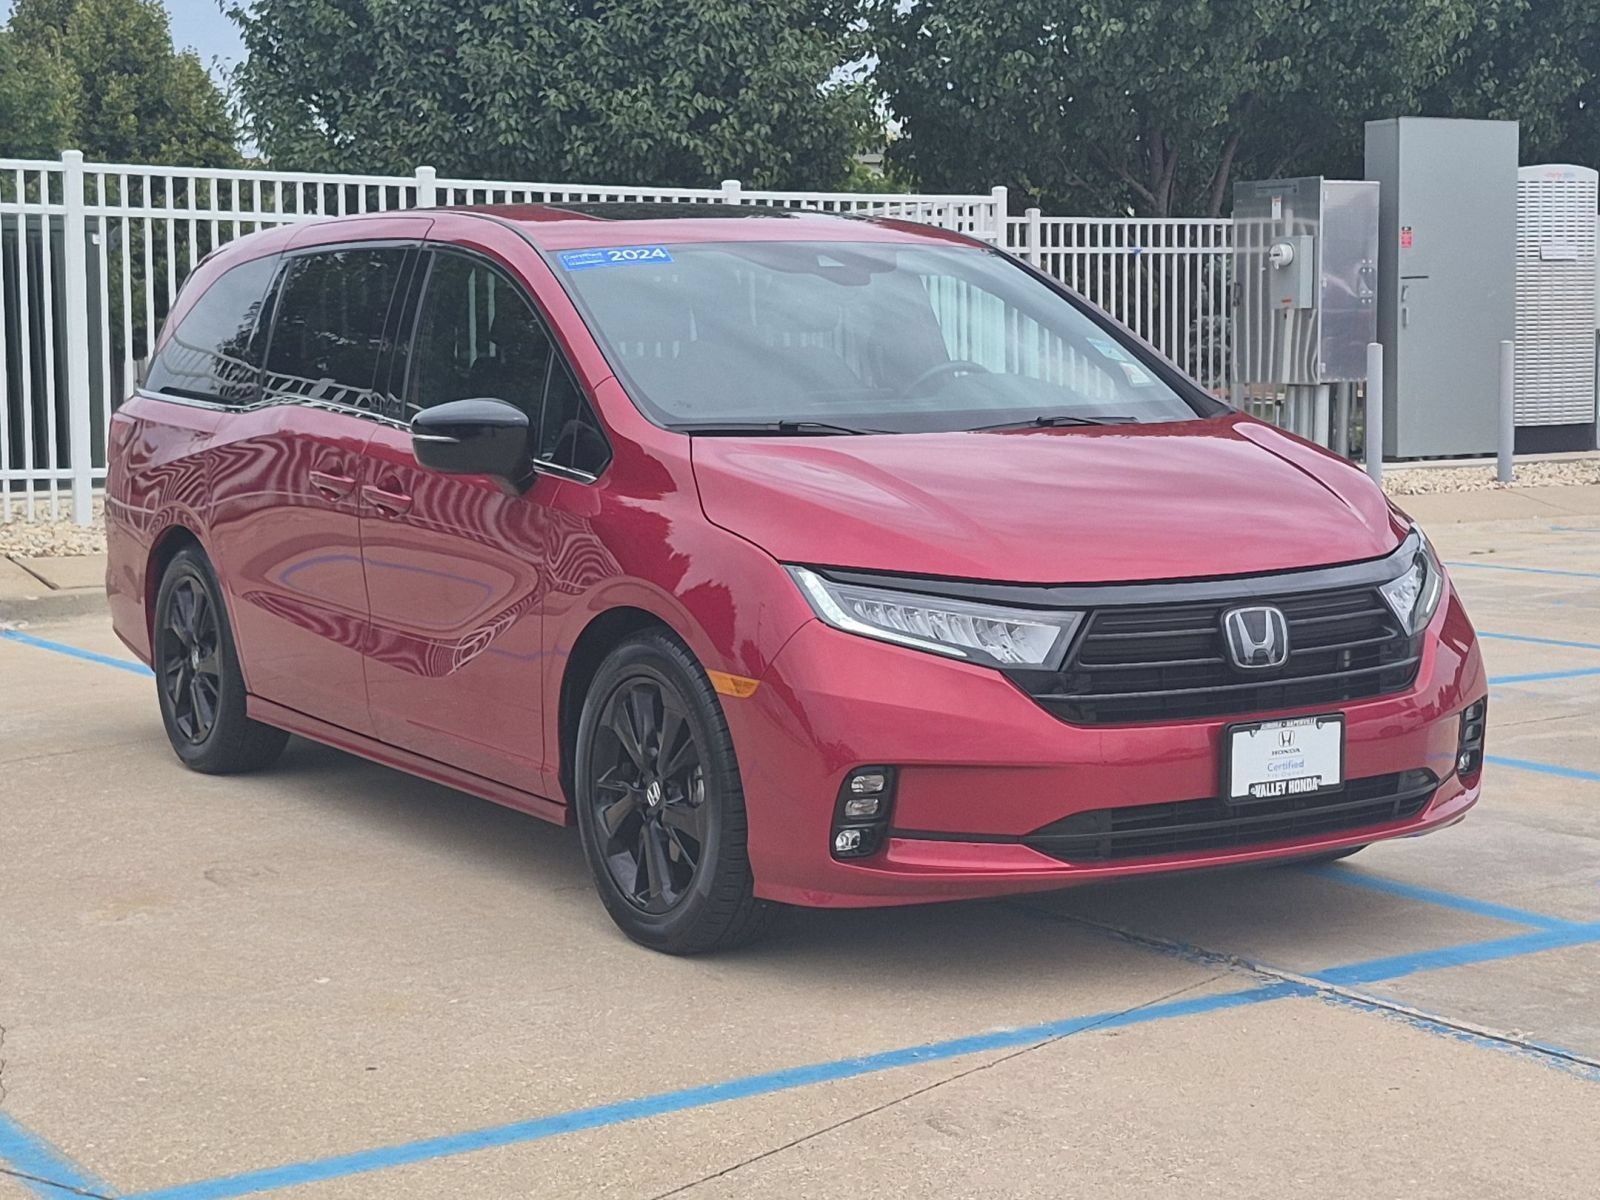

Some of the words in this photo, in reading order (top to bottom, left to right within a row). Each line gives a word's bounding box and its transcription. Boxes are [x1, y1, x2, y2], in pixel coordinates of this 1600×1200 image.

[608, 248, 667, 261] 2024
[1272, 748, 1301, 756] HONDA
[1267, 760, 1305, 772] Certified
[1255, 781, 1287, 798] VALLEY
[1288, 777, 1319, 794] HONDA
